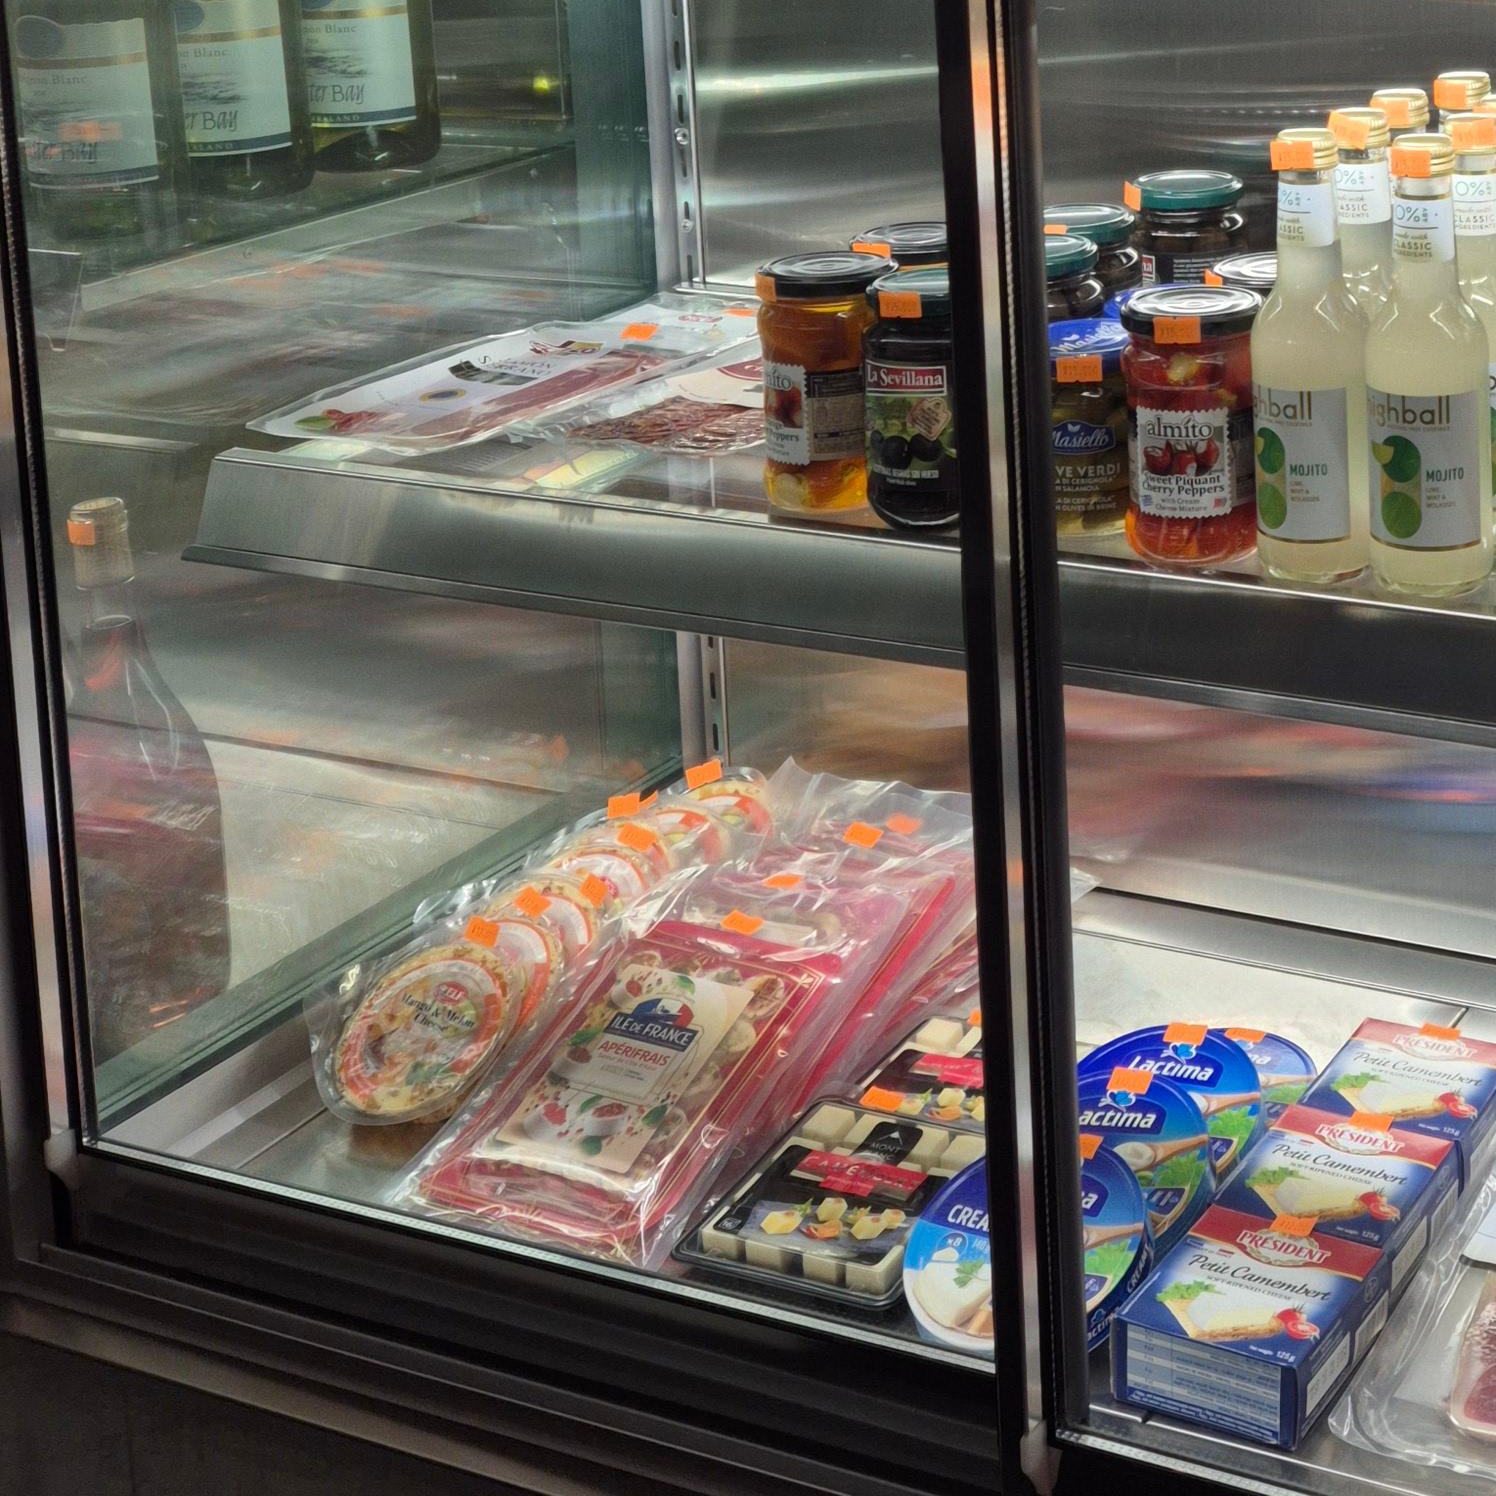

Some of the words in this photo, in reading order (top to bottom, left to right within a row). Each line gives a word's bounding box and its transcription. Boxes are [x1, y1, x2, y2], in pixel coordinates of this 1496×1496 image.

[867, 365, 878, 383] La
[880, 368, 943, 387] Sevillana
[1146, 416, 1214, 440] almíto
[1077, 462, 1121, 477] VERDI
[1175, 475, 1221, 487] Piquant
[1289, 463, 1328, 476] MOJITO
[1425, 467, 1465, 483] MOJITO
[1177, 484, 1225, 497] Peppers
[610, 1015, 630, 1031] ILE
[640, 1022, 693, 1047] FRANCE
[598, 1039, 672, 1068] APÉRIFRAIS
[1127, 1055, 1215, 1082] Lactima
[1352, 1051, 1390, 1070] Petit
[1390, 1059, 1483, 1088] Camembert
[1078, 1109, 1157, 1130] actima
[1271, 1143, 1310, 1163] Petit
[1311, 1153, 1409, 1186] Camembert
[947, 1204, 990, 1230] CREA
[1239, 1231, 1331, 1265] PRÉSIDENT
[1188, 1253, 1230, 1277] Petit
[1230, 1265, 1332, 1302] Camembert
